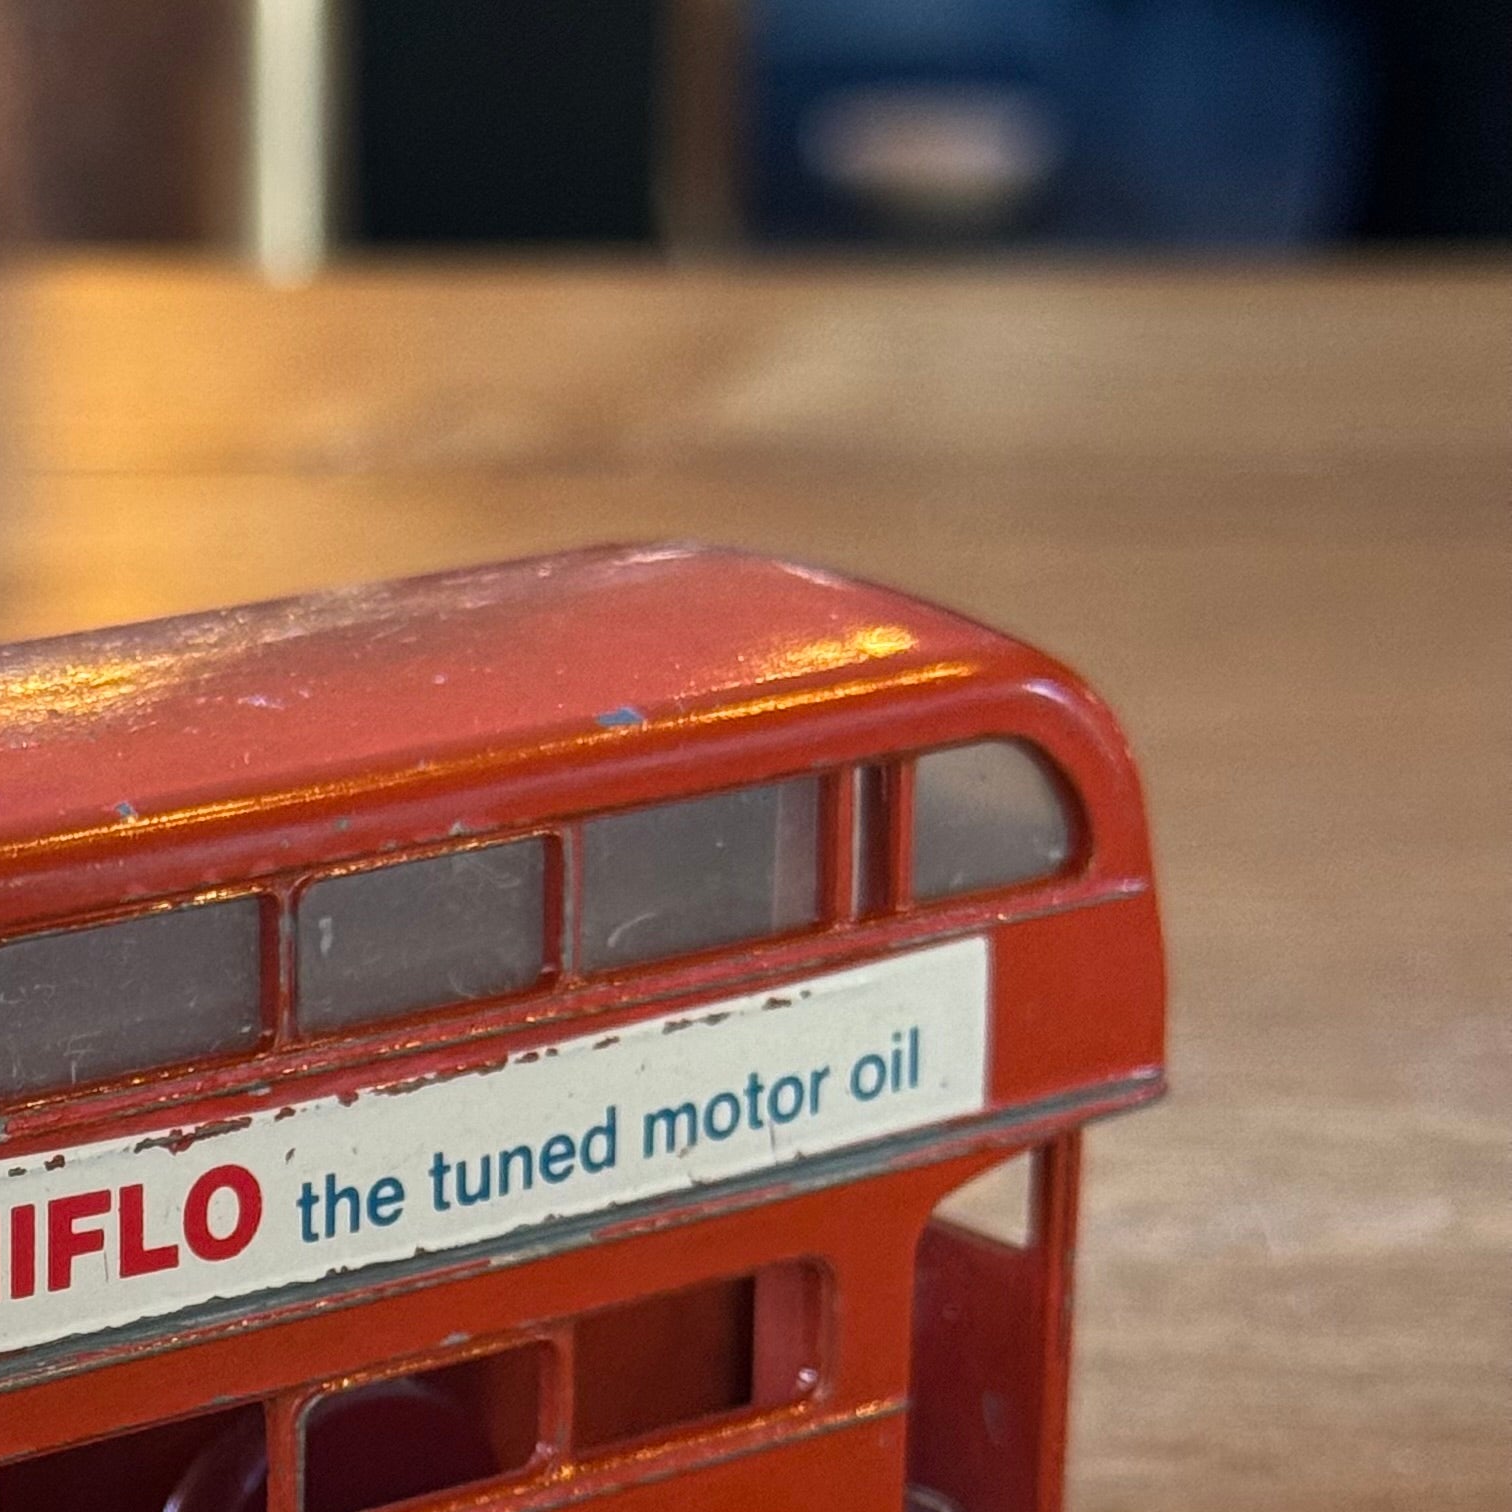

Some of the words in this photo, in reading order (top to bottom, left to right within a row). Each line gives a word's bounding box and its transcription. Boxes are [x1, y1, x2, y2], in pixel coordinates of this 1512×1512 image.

[296, 1173, 407, 1244] the
[428, 1106, 618, 1212] tuned
[642, 1065, 830, 1159] motor
[849, 1026, 921, 1102] oil
